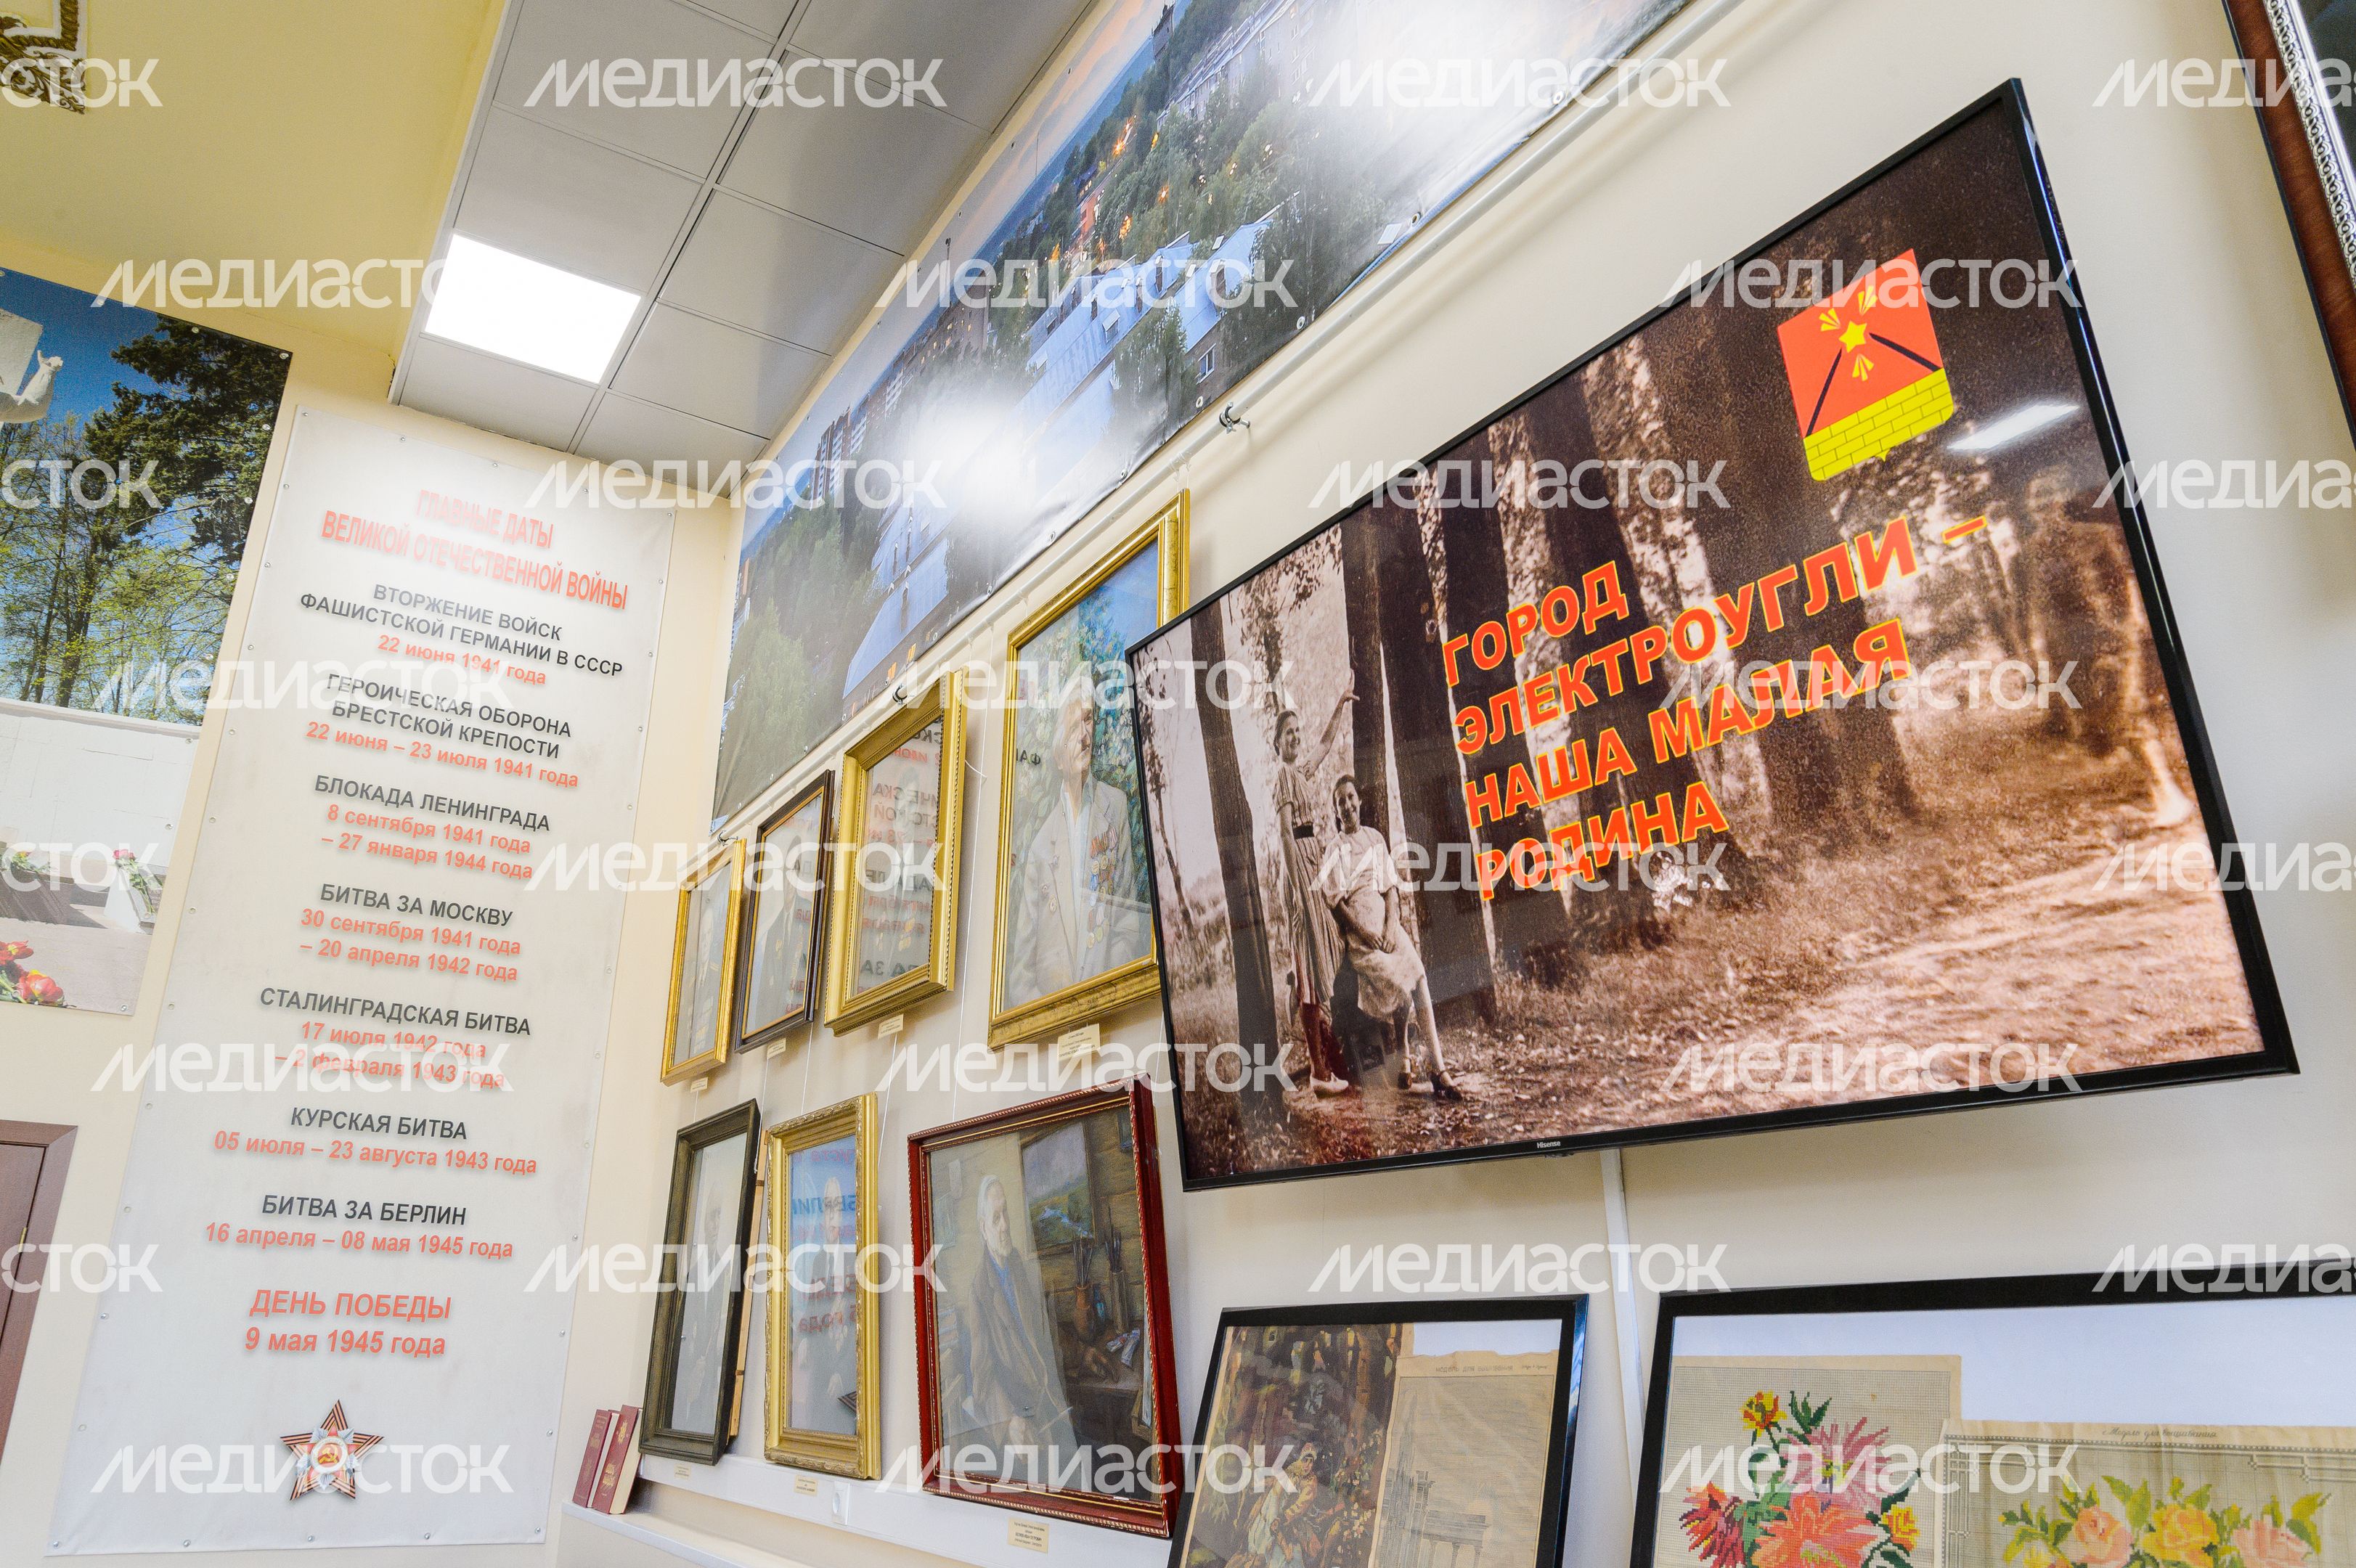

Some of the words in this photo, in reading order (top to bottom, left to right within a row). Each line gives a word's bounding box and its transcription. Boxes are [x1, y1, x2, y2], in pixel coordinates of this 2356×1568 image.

[415, 489, 502, 536] ГЛАВНЫЕ
[502, 511, 554, 553] ДАТЫ
[320, 509, 411, 558] ВЕЛИКОЙ
[412, 532, 563, 595] ОТЕЧЕСТВЕННОЙ
[565, 569, 629, 611] ВОЙНЫ
[298, 591, 444, 638] ФАШИСТСКОЙ
[449, 625, 551, 662] ГЕРМАНИИ
[556, 649, 568, 665] В
[574, 654, 622, 676] СССР
[372, 583, 494, 625] ВТОРЖЕНИЕ
[498, 612, 563, 641] ВОЙСК
[1443, 560, 1630, 687] ГОРОД
[1455, 516, 1919, 755] ЭЛЕКТРОУГЛИ
[378, 634, 400, 653] 22
[404, 642, 456, 666] июня
[461, 652, 500, 674] 1941
[506, 665, 546, 685] года
[326, 673, 473, 718] ГЕРОИЧЕСКАЯ
[477, 703, 572, 738] ОБОРОНА
[331, 699, 453, 738] БРЕСТСКОЙ
[458, 724, 559, 759] КРЕПОСТИ
[1465, 727, 1638, 830] НАША
[1648, 617, 1913, 763] МАЛАЯ
[306, 721, 329, 740] 22
[334, 730, 388, 751] июня
[409, 740, 431, 759] 23
[436, 749, 487, 769] июля
[494, 757, 532, 778] 1941
[538, 769, 579, 788] года
[314, 775, 413, 808] БЛОКАДА
[419, 793, 550, 832] ЛЕНИНГРАДА
[327, 803, 339, 821] 8
[344, 810, 436, 838] сентября
[443, 823, 483, 845] 1941
[489, 835, 530, 854] года
[338, 832, 363, 850] 27
[367, 841, 437, 865] января
[444, 849, 486, 871] 1944
[491, 860, 532, 880] года
[1475, 781, 1729, 902] РОДИНА
[320, 883, 390, 910] БИТВА
[396, 894, 423, 914] ЗА
[429, 899, 513, 926] МОСКВУ
[301, 907, 325, 928] 30
[330, 916, 423, 943] сентября
[431, 926, 472, 947] 1941
[478, 936, 521, 955] года
[317, 938, 342, 957] 20
[346, 946, 420, 967] апреля
[428, 952, 470, 974] 1942
[475, 963, 518, 982] года
[260, 987, 459, 1027] СТАЛИНГРАДСКАЯ
[464, 1011, 530, 1035] БИТВА
[302, 1021, 325, 1040] 17
[329, 1029, 386, 1045] июля
[391, 1030, 439, 1053] 1942
[441, 1040, 487, 1061] года
[291, 1048, 307, 1068] 2
[309, 1051, 405, 1082] февраля
[410, 1061, 457, 1083] 1943
[461, 1069, 505, 1090] года
[290, 1107, 391, 1133] КУРСКАЯ
[396, 1116, 466, 1140] БИТВА
[214, 1130, 240, 1151] 05
[245, 1138, 305, 1156] июля
[327, 1139, 354, 1159] 23
[359, 1146, 437, 1168] августа
[444, 1149, 488, 1169] 1943
[493, 1156, 537, 1175] года
[261, 1194, 337, 1217] БИТВА
[344, 1200, 372, 1220] ЗА
[380, 1202, 466, 1225] БЕРЛИН
[206, 1222, 230, 1243] 16
[235, 1228, 316, 1249] апреля
[341, 1230, 365, 1250] 08
[370, 1236, 410, 1252] мая
[420, 1234, 463, 1255] 1945
[468, 1241, 513, 1259] года
[248, 1289, 326, 1318] ДЕНЬ
[334, 1292, 451, 1323] ПОБЕДЫ
[245, 1326, 260, 1349] 9
[267, 1333, 317, 1351] мая
[327, 1328, 384, 1353] 1945
[390, 1336, 445, 1357] года
